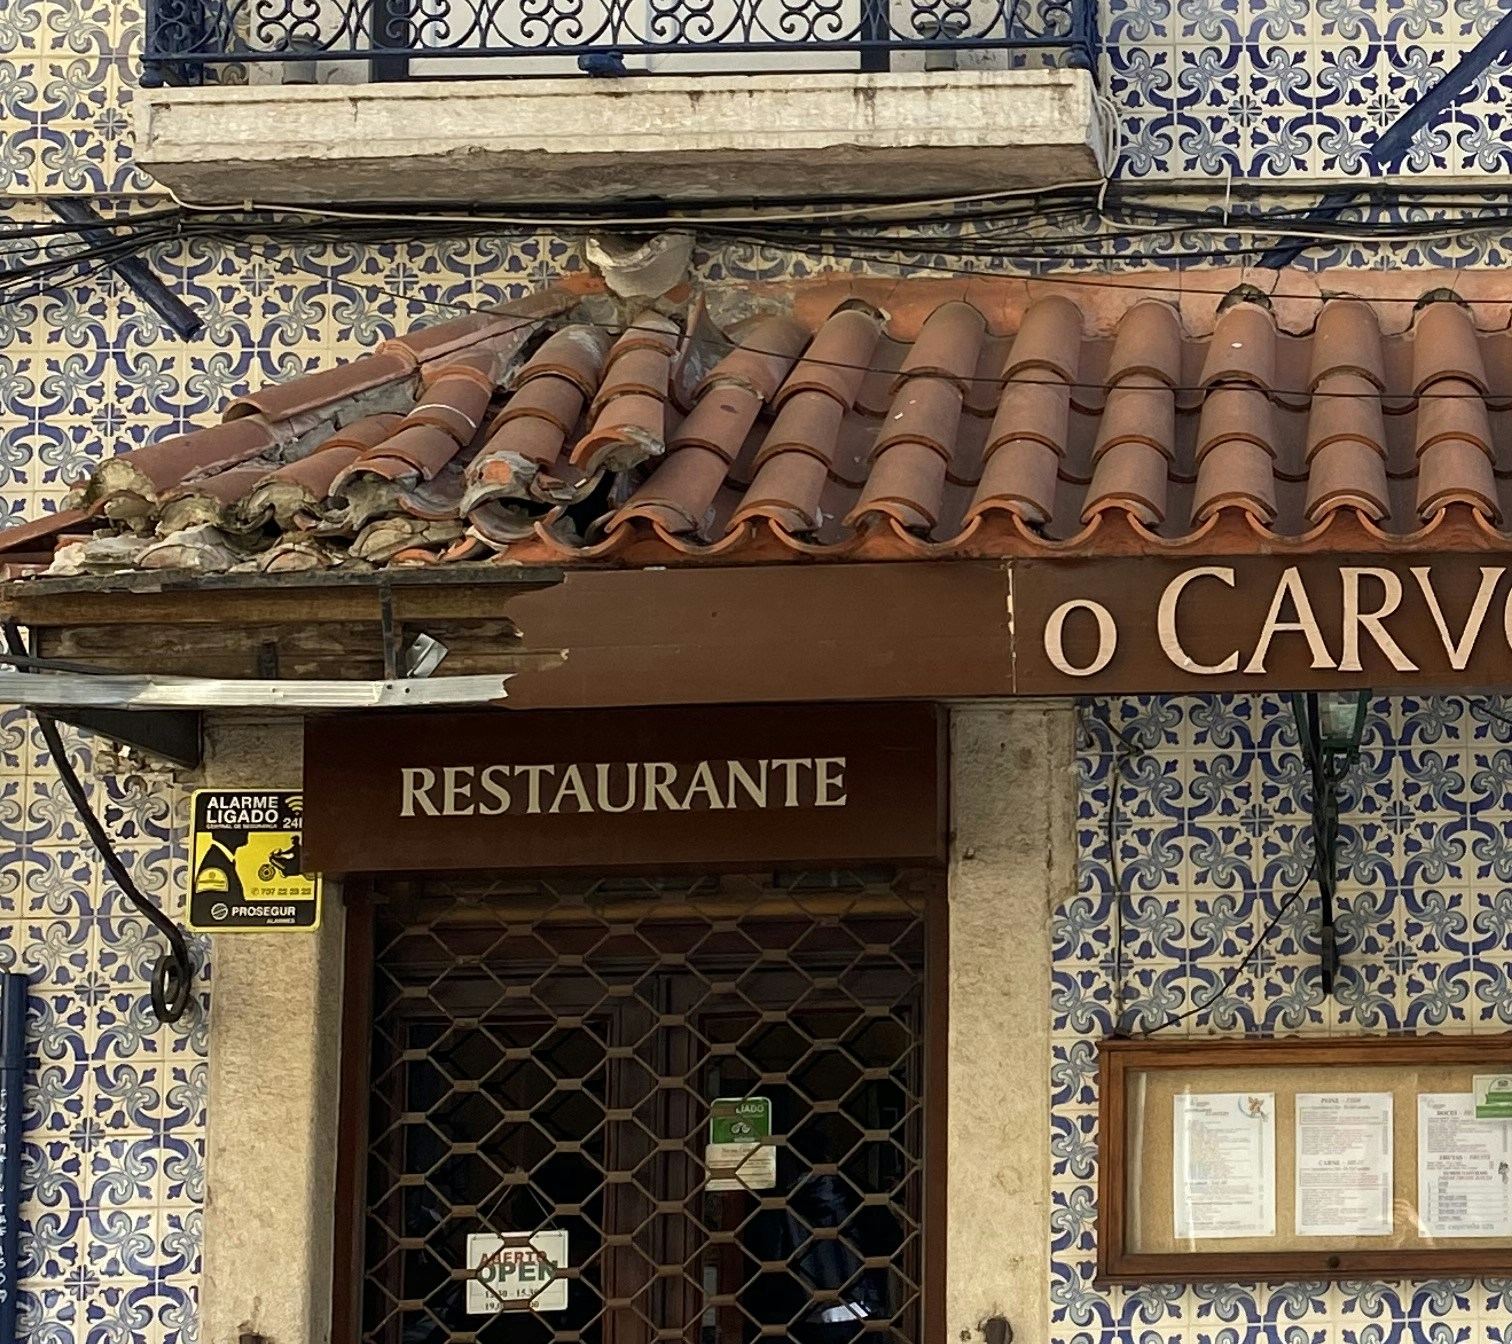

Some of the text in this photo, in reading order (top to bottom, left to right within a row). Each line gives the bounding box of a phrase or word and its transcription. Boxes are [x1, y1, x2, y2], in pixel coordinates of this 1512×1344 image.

[400, 757, 847, 817] RESTAURANTE
[207, 796, 279, 809] ALARME
[206, 809, 279, 823] LIGADO
[231, 906, 296, 917] PROSEGUR
[478, 1260, 558, 1284] OPEN
